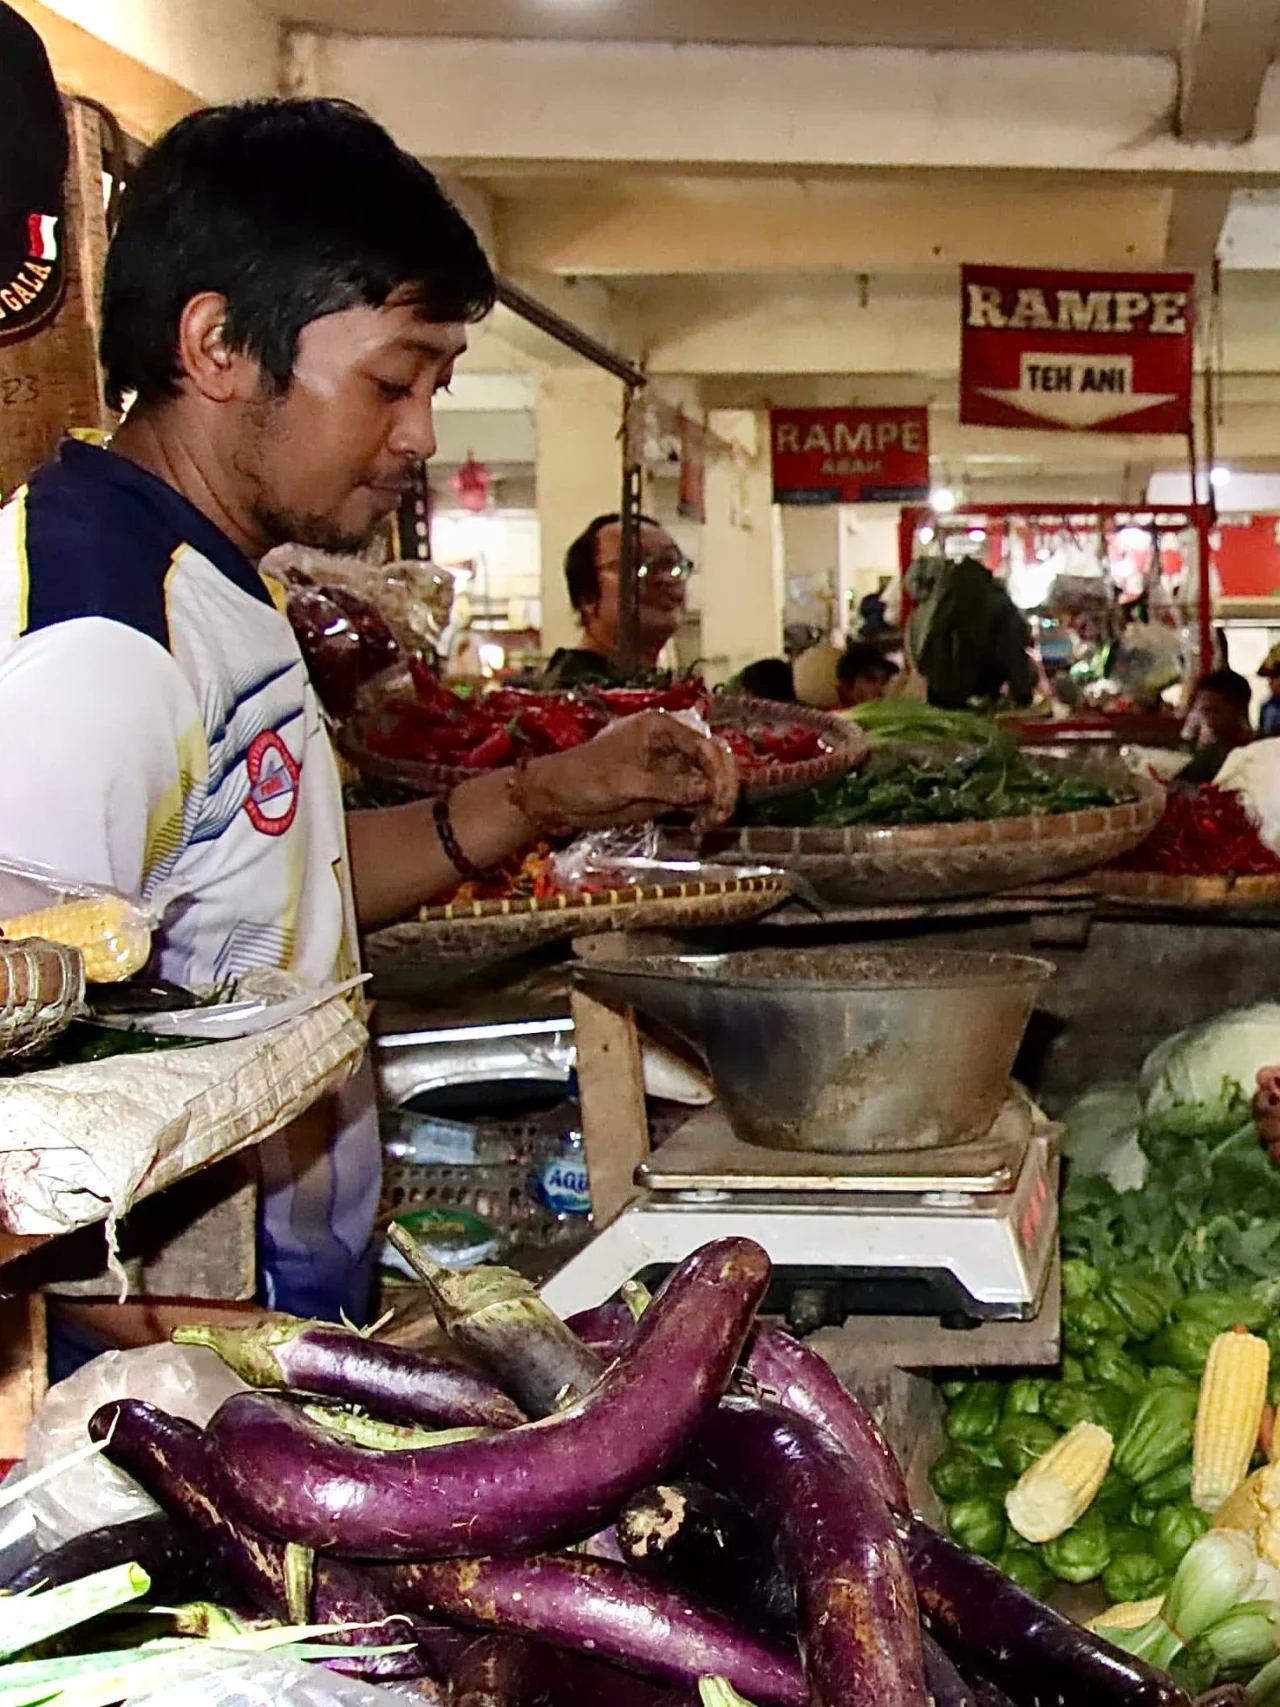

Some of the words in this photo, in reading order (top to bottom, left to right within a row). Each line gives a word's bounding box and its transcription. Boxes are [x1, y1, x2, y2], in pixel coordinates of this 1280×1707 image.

[0, 261, 52, 320] GALA
[967, 284, 1186, 333] RAMPE
[1028, 364, 1071, 392] TEH
[1080, 366, 1125, 394] ANI
[776, 421, 921, 453] RAMPE
